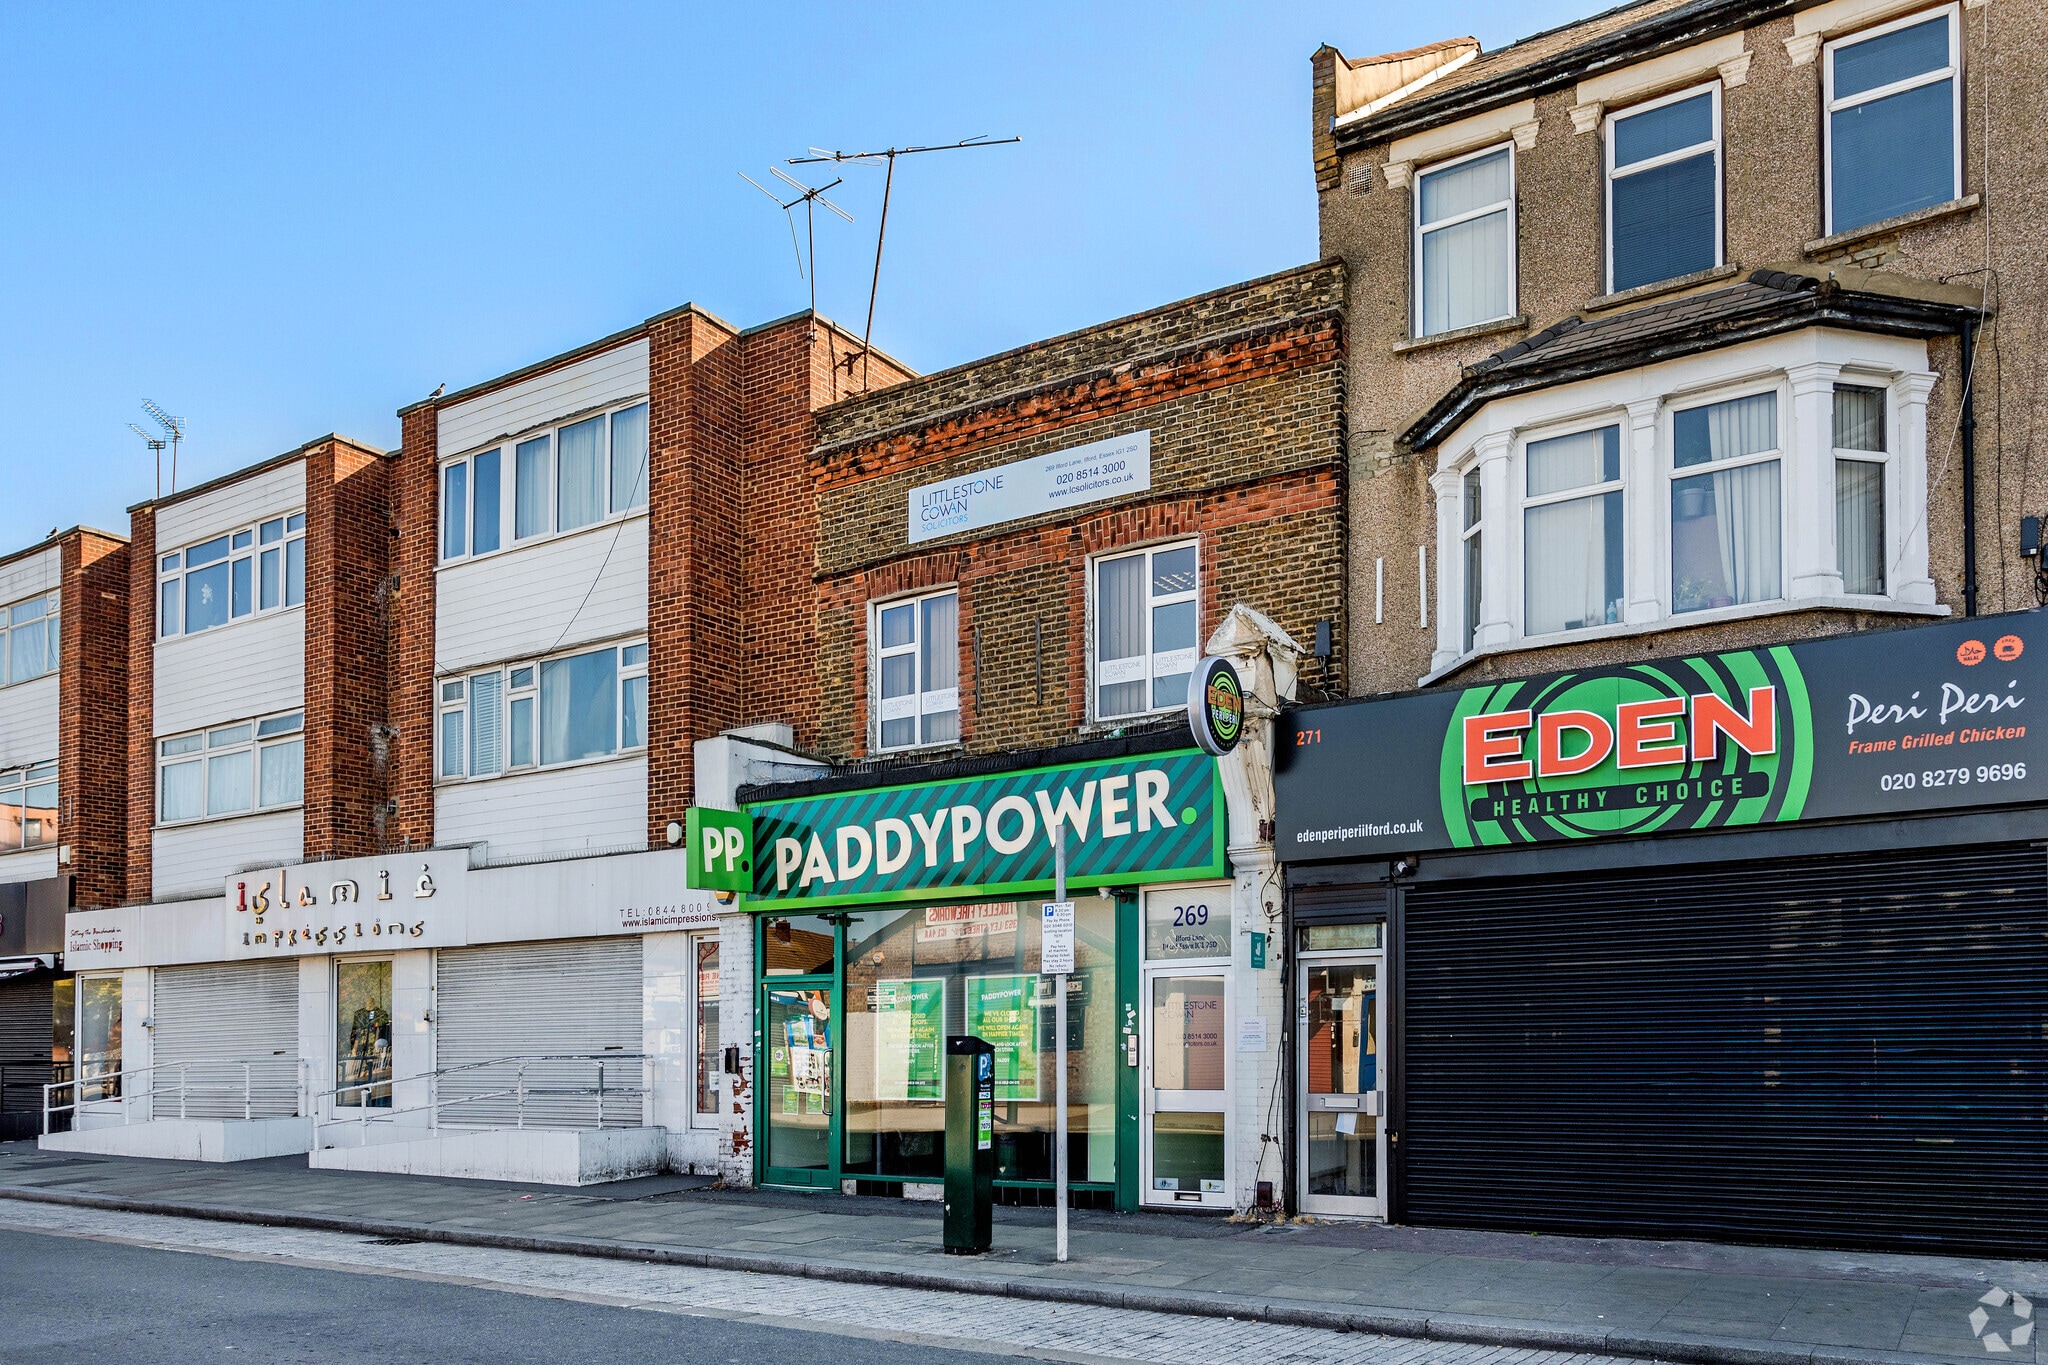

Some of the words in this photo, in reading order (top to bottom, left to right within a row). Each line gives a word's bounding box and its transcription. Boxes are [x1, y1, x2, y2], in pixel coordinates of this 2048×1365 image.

[1056, 461, 1068, 470] Ilford
[1099, 452, 1114, 460] Essex
[1126, 445, 1138, 453] 2SD
[1056, 472, 1074, 485] 020
[1076, 466, 1100, 481] 8514
[1102, 460, 1126, 475] 3000
[922, 474, 1004, 508] LITTLESTONE
[1048, 472, 1134, 498] www.lcsolicitors.co.uk
[921, 499, 968, 522] COWAN
[921, 514, 968, 532] SOLICITORS
[1105, 661, 1141, 672] LITTLESTONE
[1156, 653, 1193, 664] LITTLESTONE
[1156, 662, 1177, 670] COWAN
[925, 692, 956, 702] LITTLESTONE
[1208, 685, 1241, 712] EDEN
[1847, 691, 1927, 735] Peri
[1939, 680, 2025, 725] Peri
[1296, 729, 1321, 746] 271
[1463, 685, 1776, 785] EDEN
[1848, 740, 1896, 755] Frame
[1901, 731, 1954, 750] Grilled
[1960, 726, 2026, 744] Chicken
[1880, 772, 1916, 791] 020
[1922, 768, 1970, 788] 8279
[1976, 762, 2026, 783] 9696
[1493, 791, 1608, 817] HEALTHY
[1636, 777, 1743, 804] CHOICE
[1297, 819, 1423, 844] edenperiperiilford.co.uk
[681, 902, 702, 913] 800
[1174, 904, 1208, 927] 269
[70, 940, 91, 952] Islamic
[93, 938, 123, 953] Shopping
[1165, 1000, 1217, 1010] ITTLESTONE
